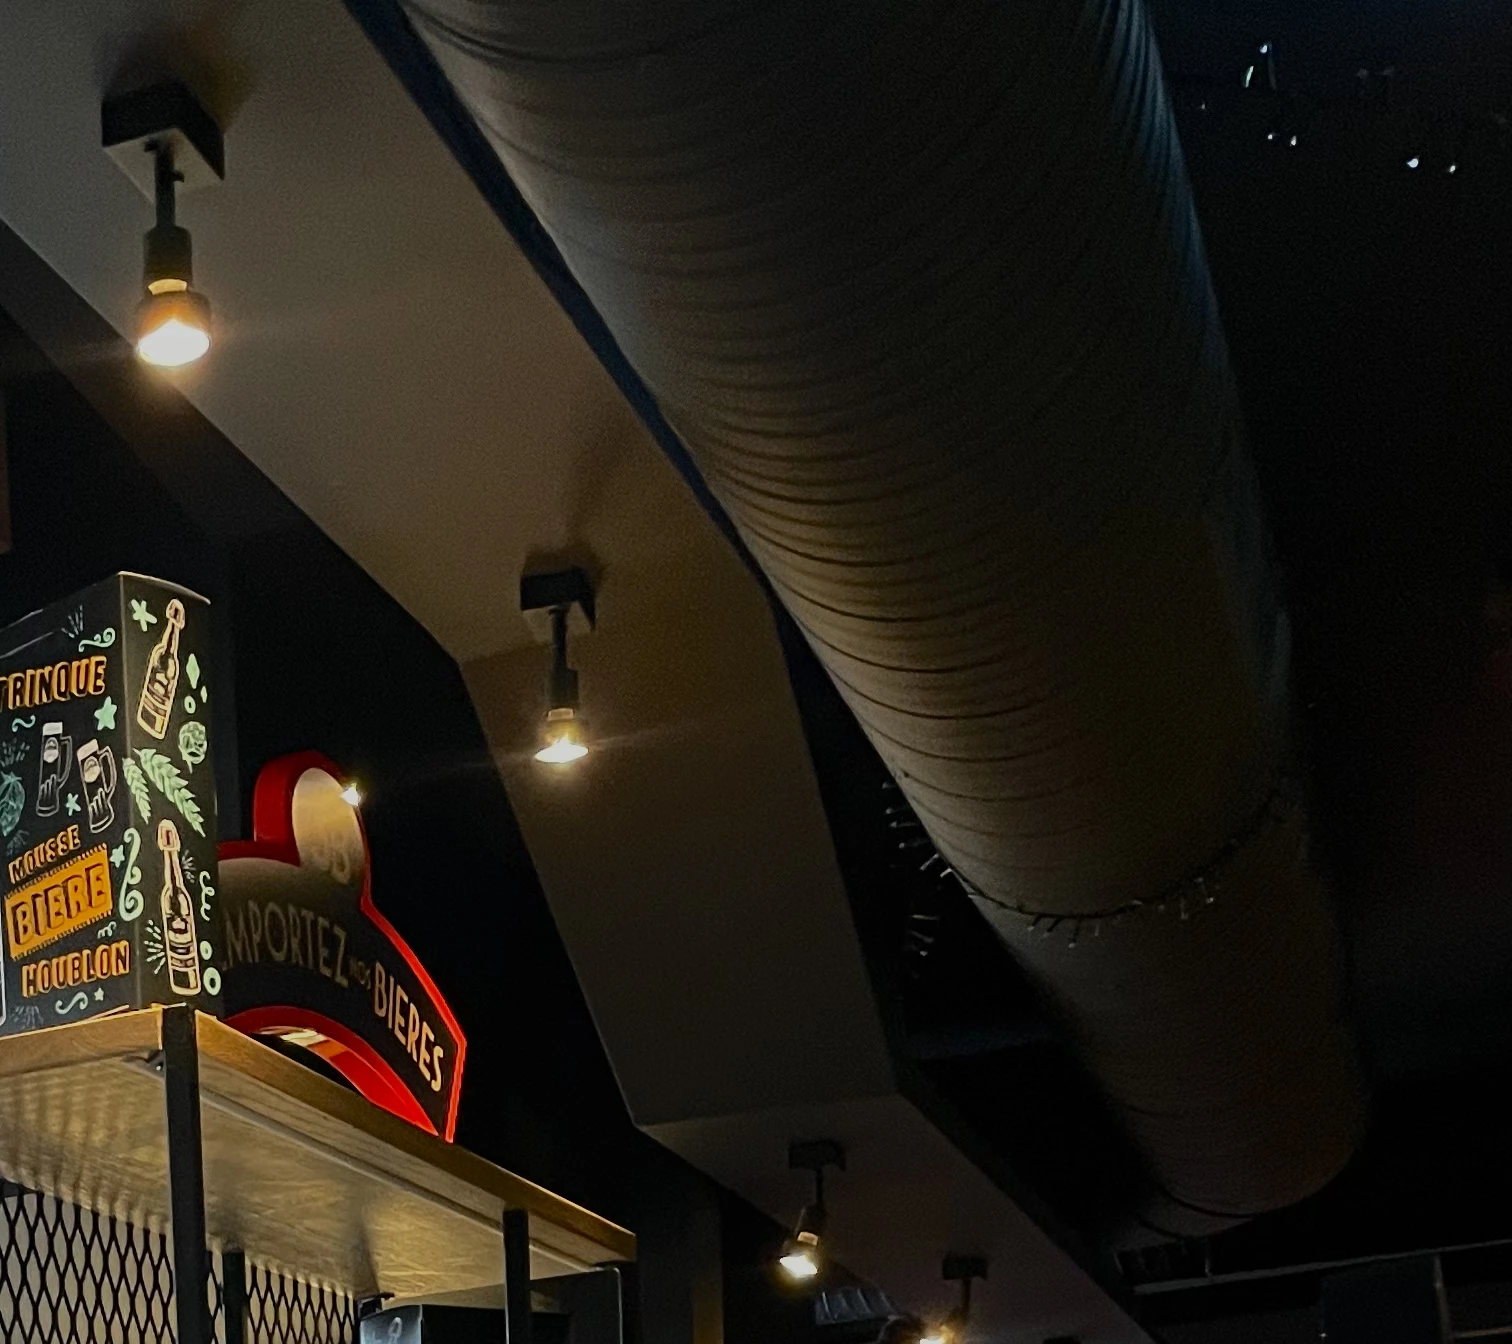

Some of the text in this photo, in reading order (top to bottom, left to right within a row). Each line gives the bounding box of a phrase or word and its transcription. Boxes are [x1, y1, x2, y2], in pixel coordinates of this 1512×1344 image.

[8, 824, 81, 884] MOUSSE
[13, 863, 107, 946] BIERE
[22, 940, 130, 998] HOUBLON
[222, 899, 349, 988] MPORTEZ
[373, 960, 445, 1092] BIERES
